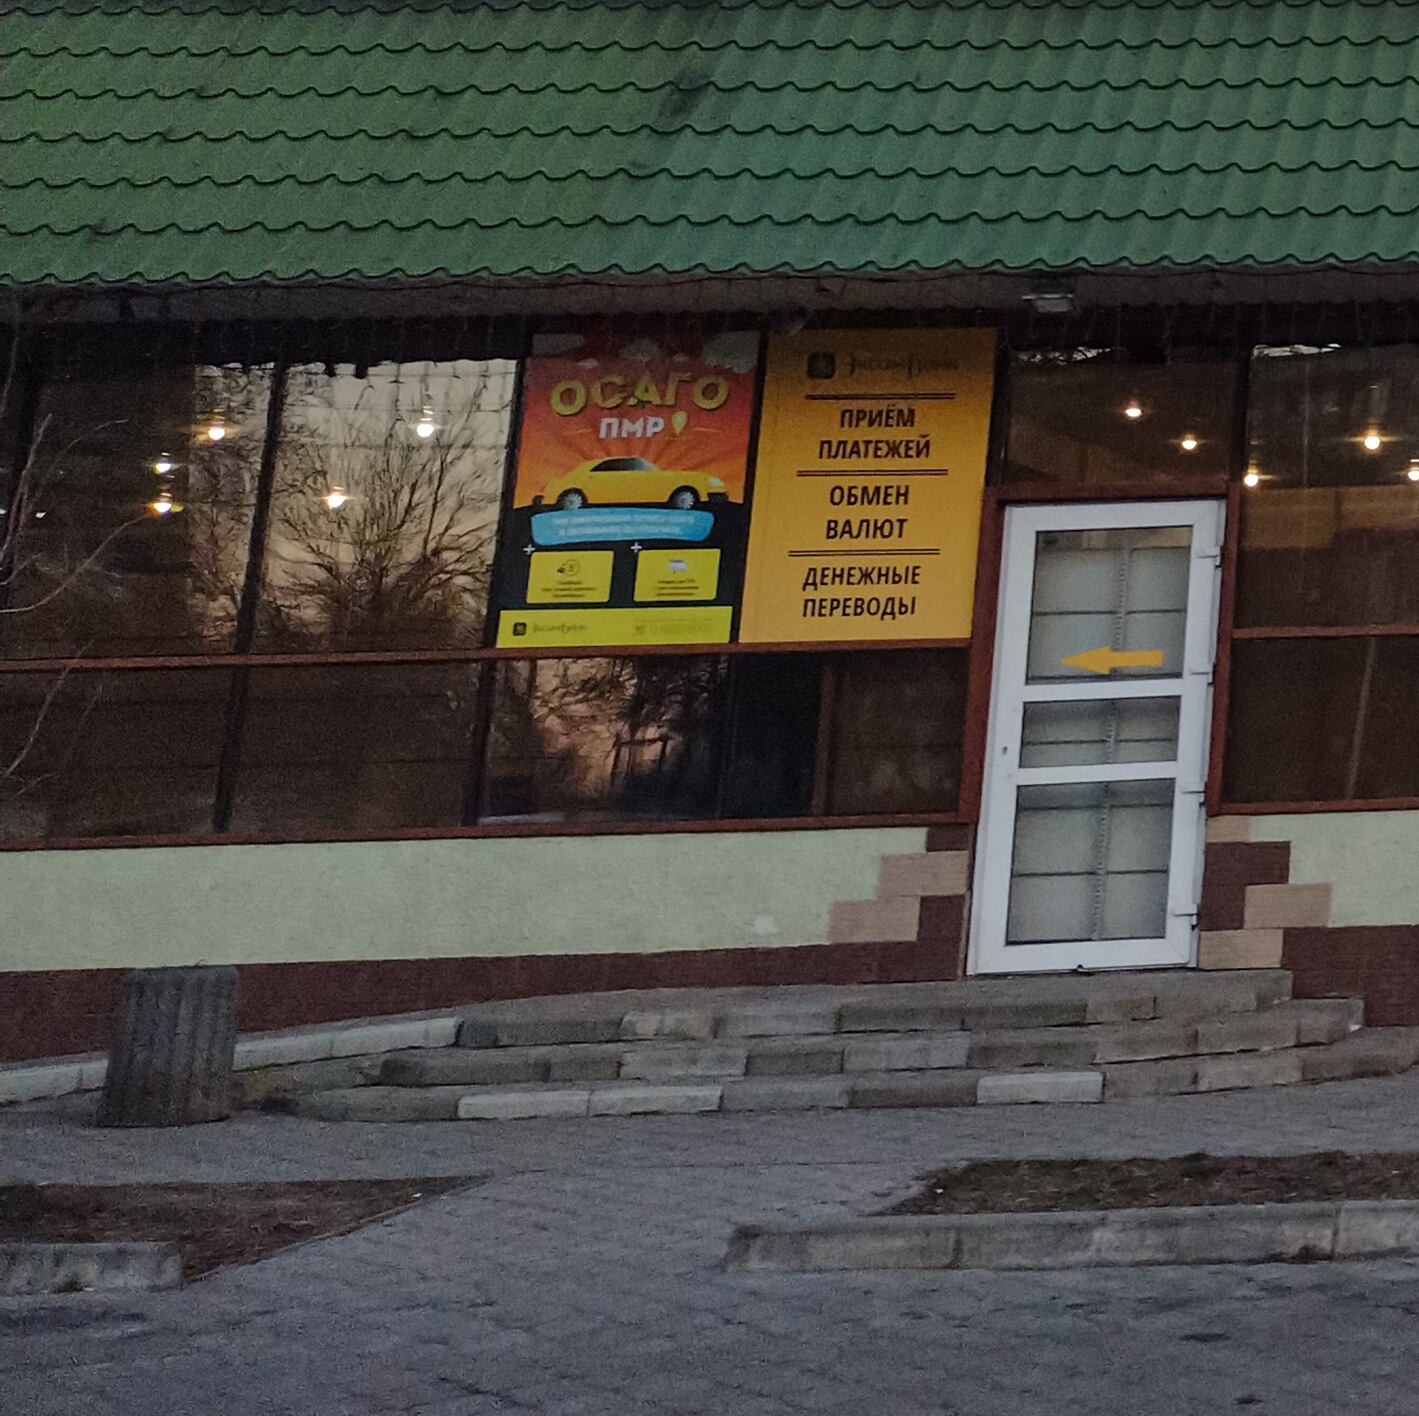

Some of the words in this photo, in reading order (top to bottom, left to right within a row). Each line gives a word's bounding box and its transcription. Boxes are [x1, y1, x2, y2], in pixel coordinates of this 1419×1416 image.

[549, 372, 729, 416] ОСАГО
[840, 404, 916, 428] ПРИЁМ
[818, 434, 931, 460] ПЛАТЕЖЕЙ
[829, 485, 910, 507] ОБМЕН
[825, 519, 908, 540] ВАЛЮТ
[802, 565, 921, 591] ДЕНЕЖНЫЕ
[802, 597, 917, 621] ПЕРЕВОДЫ
